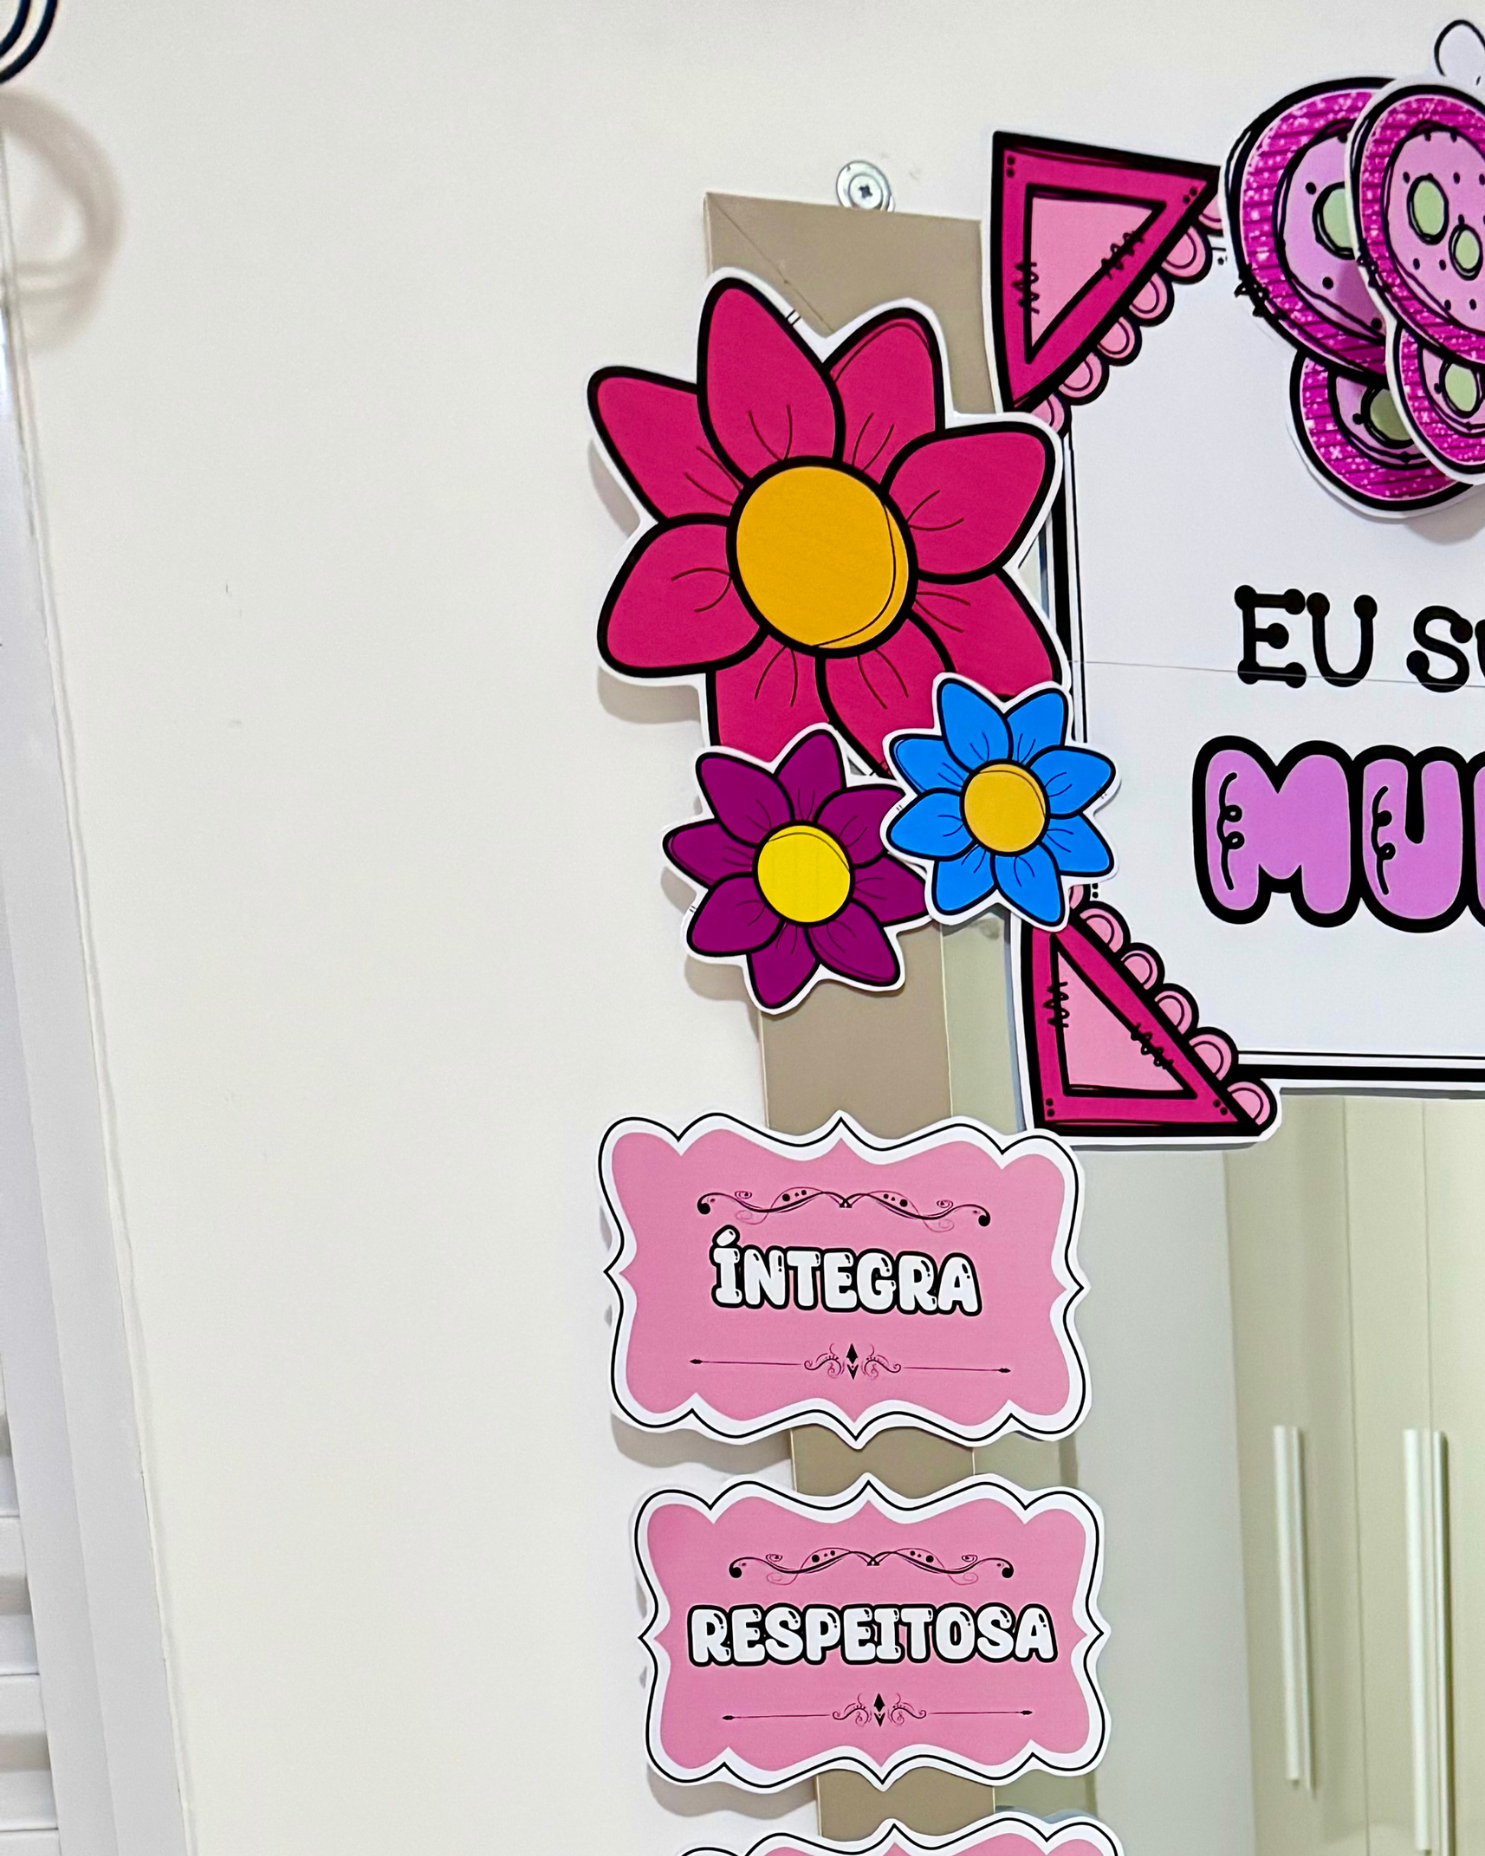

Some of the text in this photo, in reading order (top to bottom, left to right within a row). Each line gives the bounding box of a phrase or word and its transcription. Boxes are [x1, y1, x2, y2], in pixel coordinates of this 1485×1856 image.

[1234, 585, 1377, 688] EU
[709, 1225, 982, 1316] ÍNTEGRA
[687, 1603, 1058, 1667] RESPEITOSA
